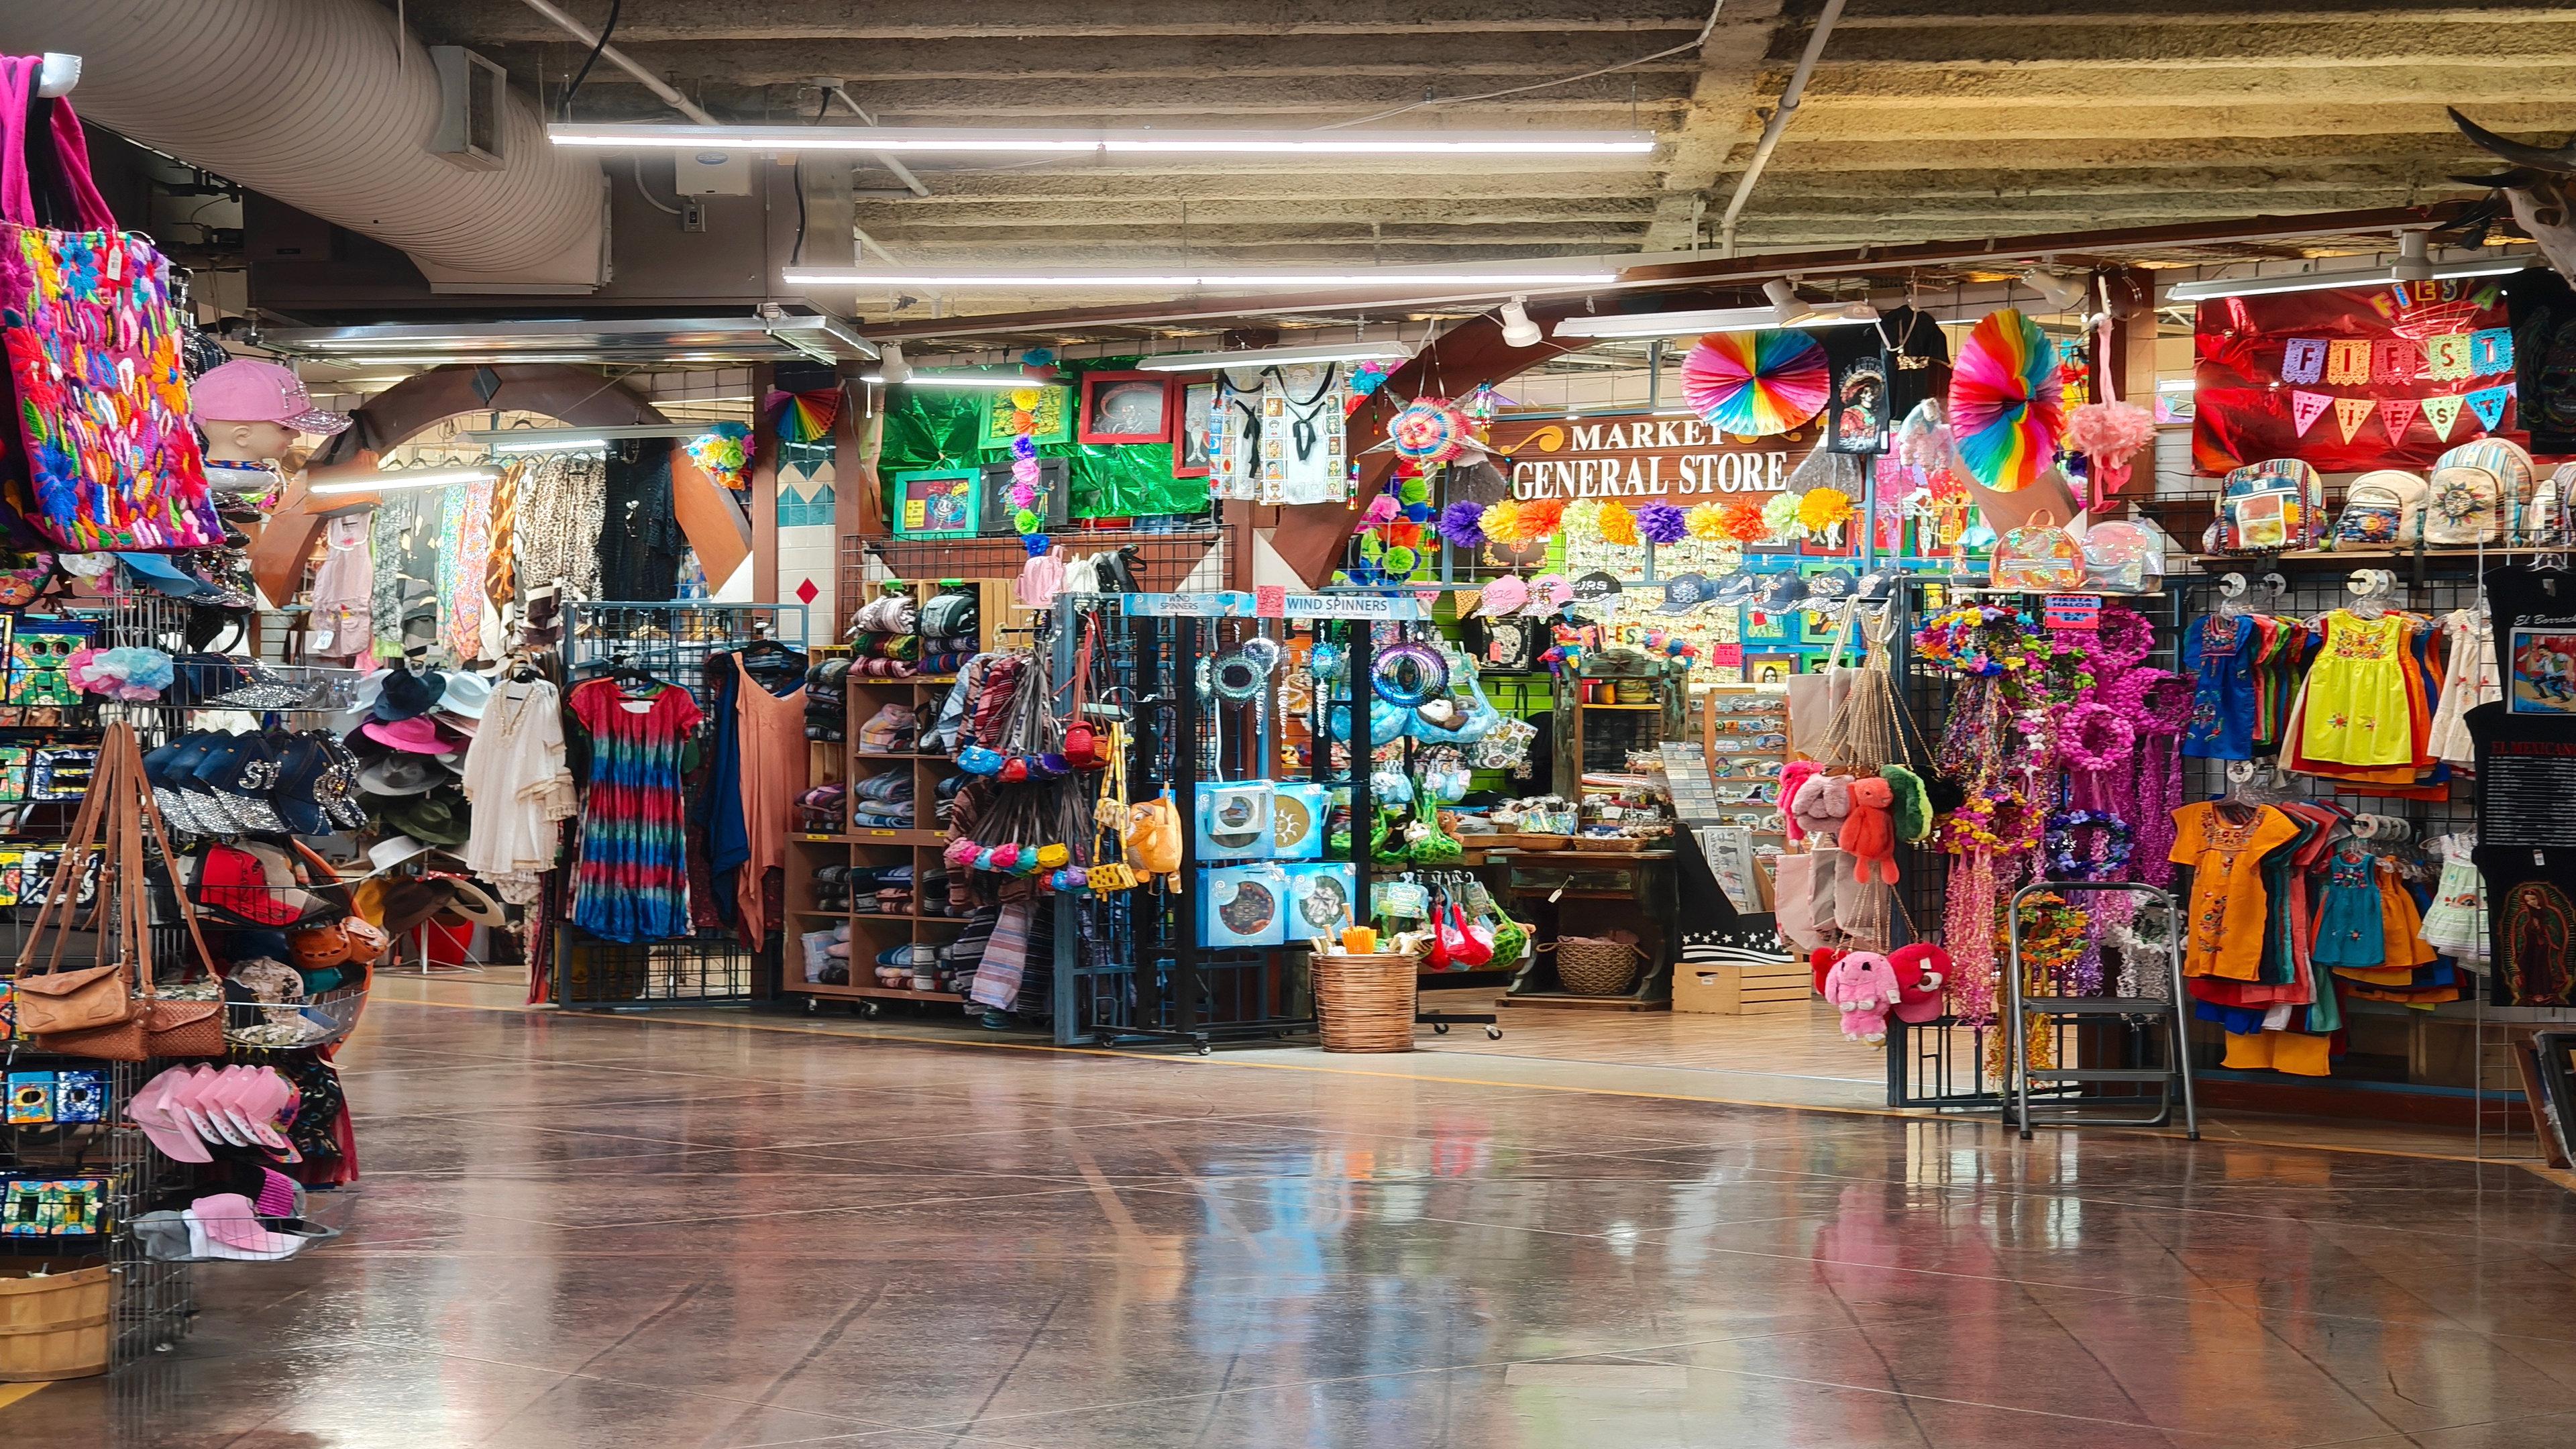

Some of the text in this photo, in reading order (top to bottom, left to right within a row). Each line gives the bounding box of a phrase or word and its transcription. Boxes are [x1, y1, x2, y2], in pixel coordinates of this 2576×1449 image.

[2370, 279, 2500, 319] FIESA
[2300, 338, 2498, 371] FIEST
[2300, 400, 2495, 427] FIEST
[1570, 419, 1725, 451] MARKET
[1513, 451, 1790, 500] GENERAL STORE
[1287, 598, 1388, 612] WIND SPINNERS
[2514, 614, 2531, 626] El
[2490, 741, 2576, 756] EL MEXICAN
